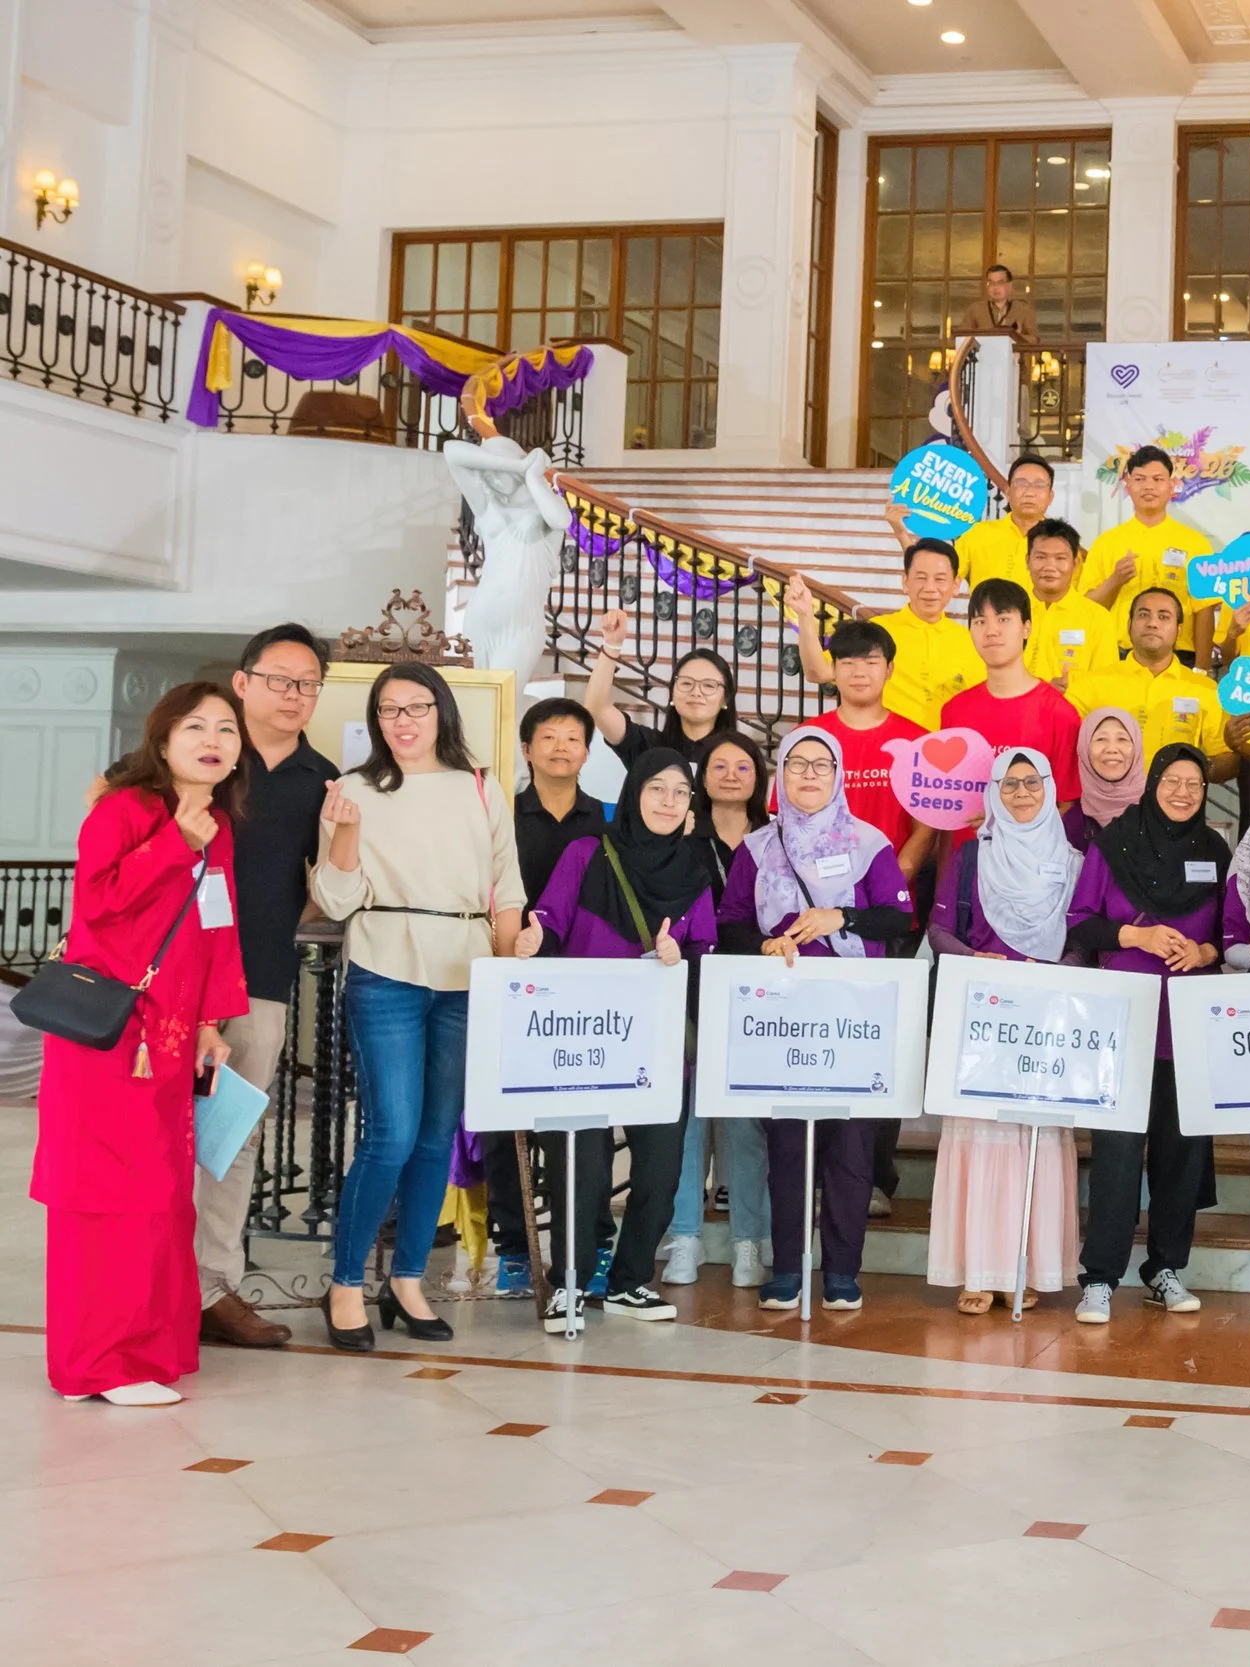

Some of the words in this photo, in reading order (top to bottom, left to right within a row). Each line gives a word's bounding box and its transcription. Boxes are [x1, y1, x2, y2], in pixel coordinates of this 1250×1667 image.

[922, 450, 979, 489] EVERY
[910, 462, 974, 506] SENIOR
[891, 477, 911, 498] A
[913, 482, 976, 524] Volunteer
[1213, 576, 1227, 595] is
[1235, 666, 1243, 681] I
[913, 752, 919, 767] I
[863, 769, 889, 779] COR
[527, 1009, 633, 1042] Admiralty
[743, 1015, 829, 1038] Canberra
[836, 1018, 881, 1040] Vista
[969, 1021, 992, 1042] SC
[998, 1023, 1019, 1044] EC
[1024, 1025, 1066, 1048] Zone
[1071, 1029, 1082, 1049] 3
[1087, 1030, 1100, 1050] &
[1107, 1031, 1117, 1052] 4
[553, 1048, 582, 1069] (Bus
[587, 1047, 605, 1069] 13)
[786, 1048, 817, 1068] (Bus
[823, 1048, 835, 1069] 7)
[1017, 1054, 1048, 1075] (Bus
[1052, 1057, 1065, 1078] 6)
